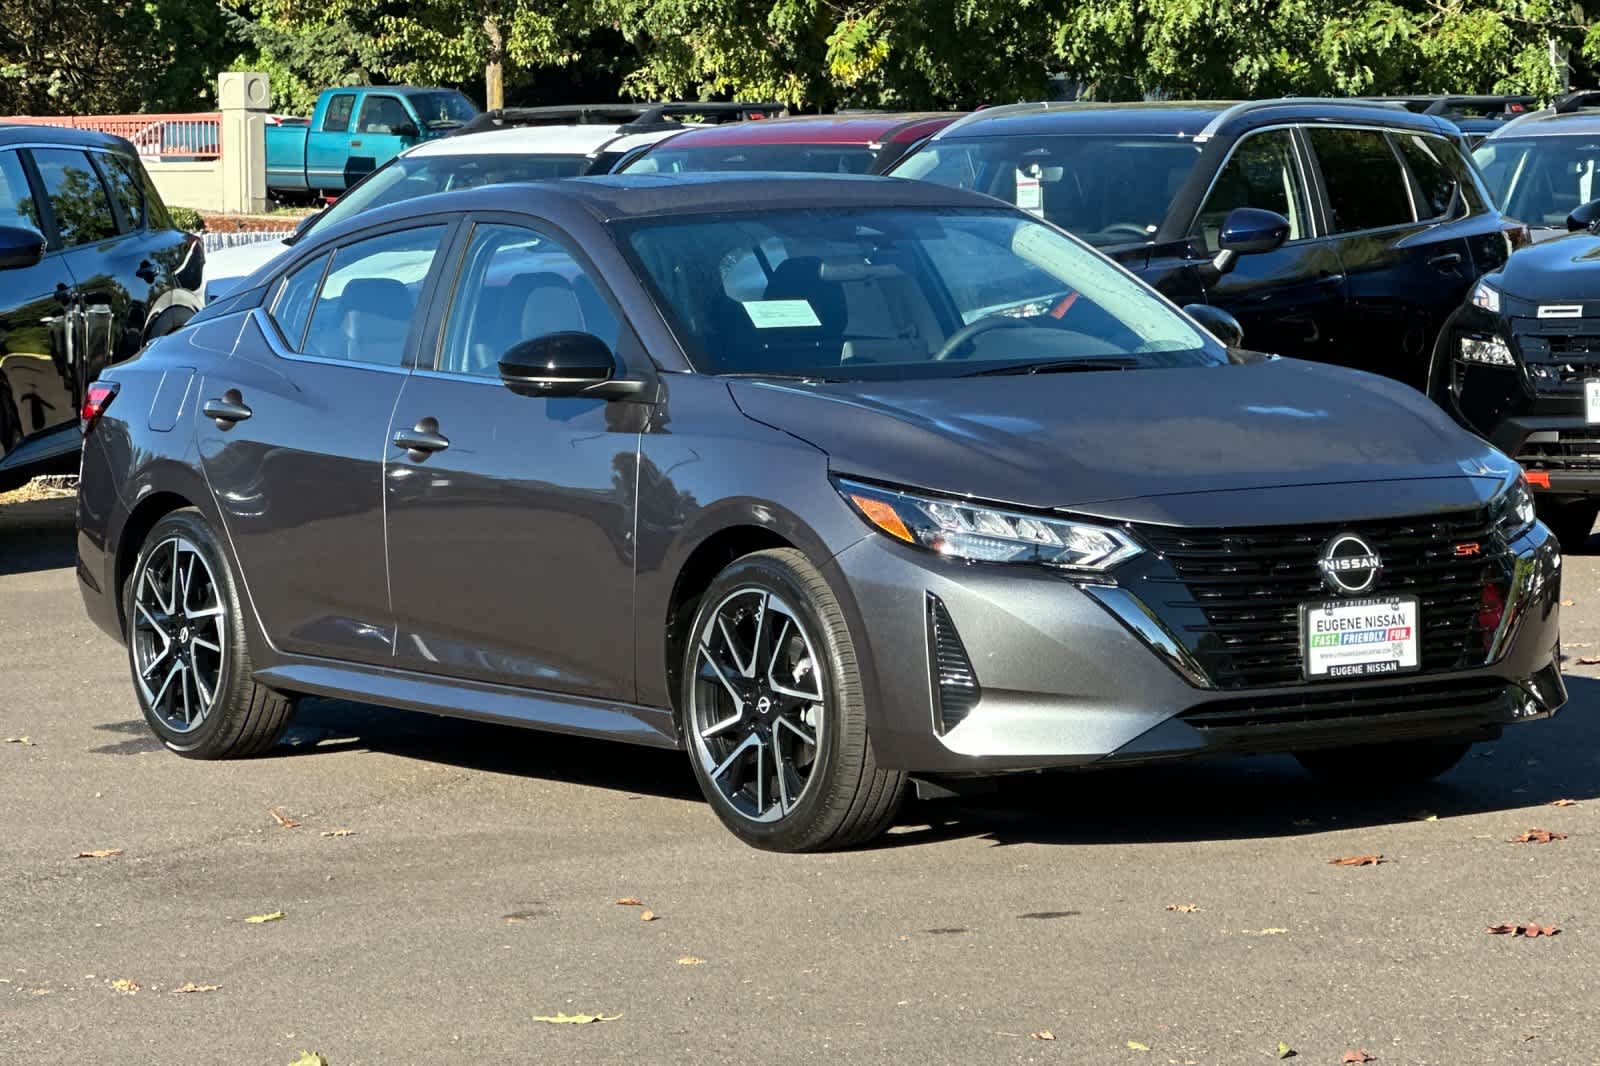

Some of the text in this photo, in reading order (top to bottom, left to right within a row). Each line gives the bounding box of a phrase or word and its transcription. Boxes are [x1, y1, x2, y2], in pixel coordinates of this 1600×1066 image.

[1454, 543, 1481, 556] SR
[1324, 557, 1379, 571] NISSAN
[1316, 613, 1406, 632] EUGENE NISSAN
[1330, 661, 1397, 677] EUGENE NISSAN
